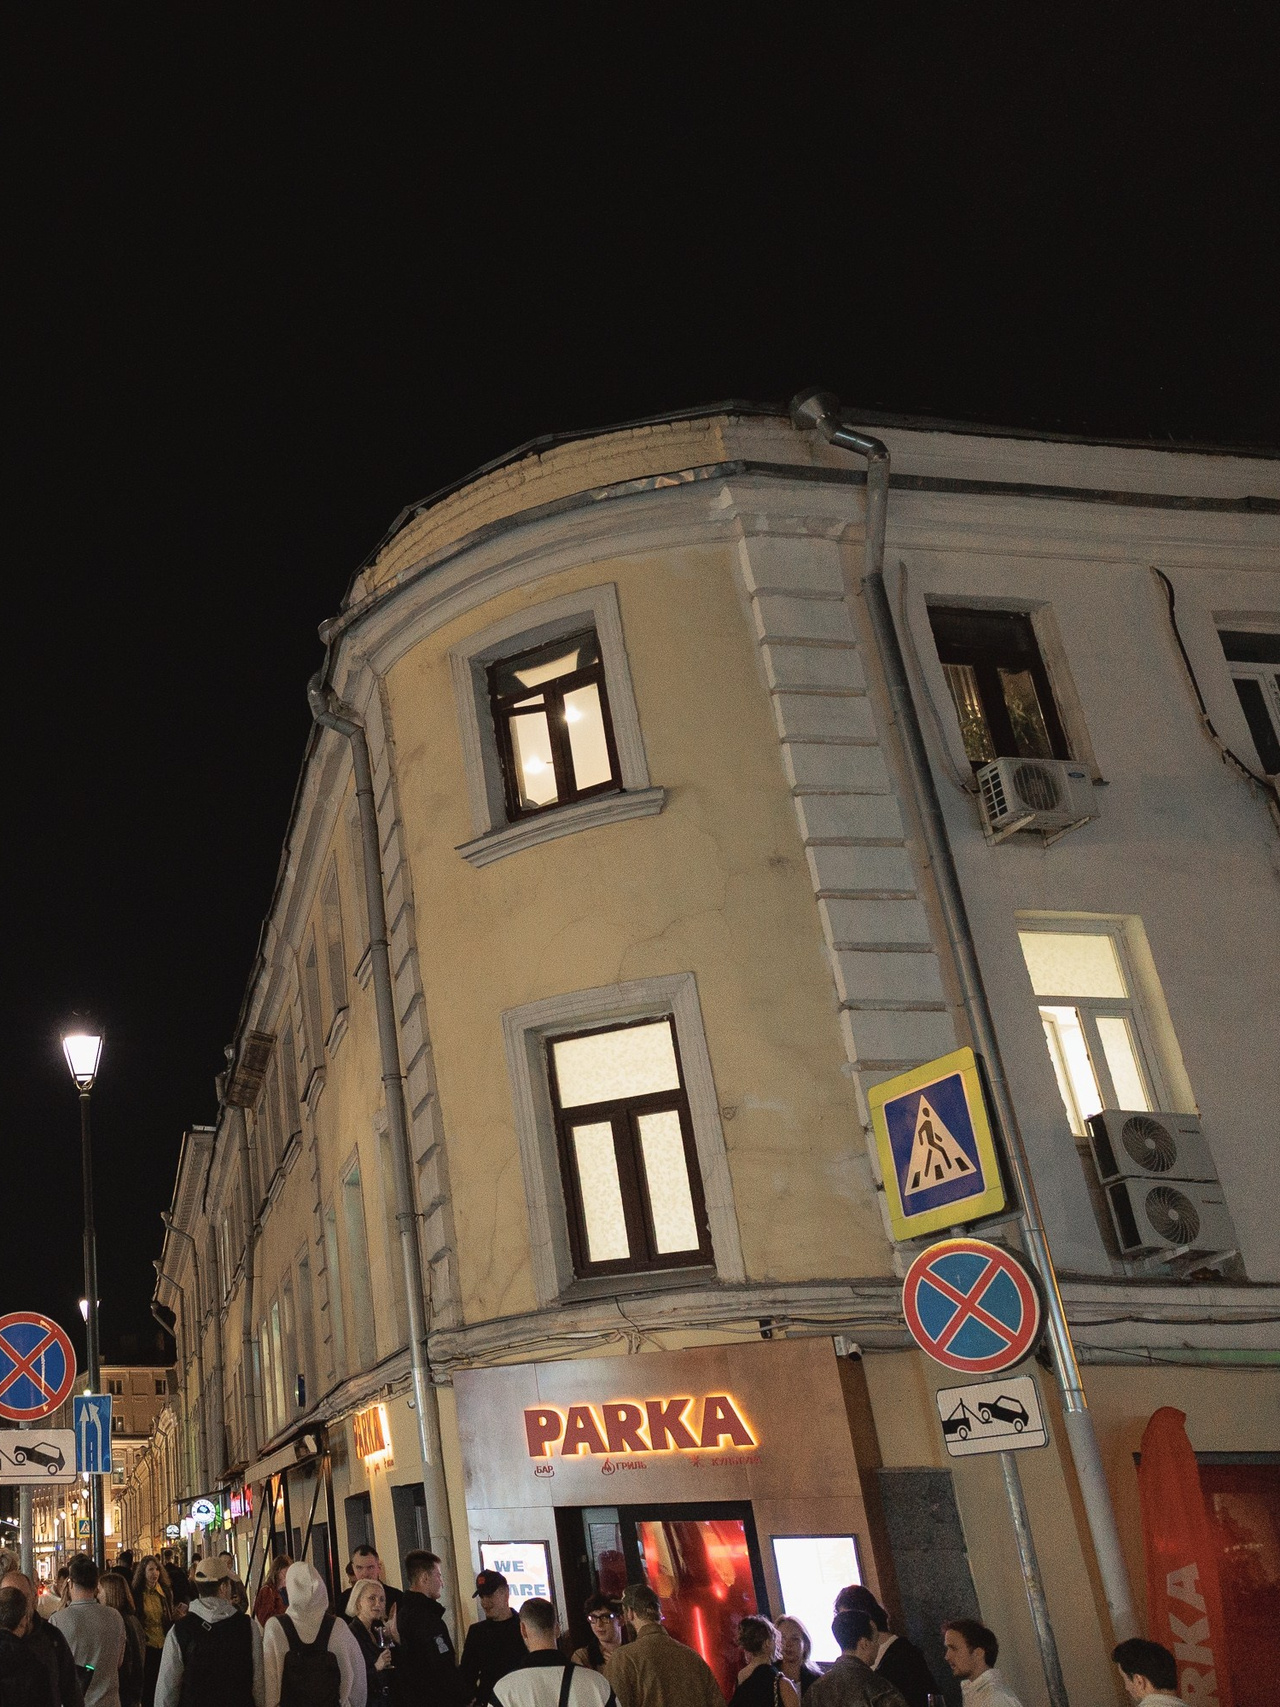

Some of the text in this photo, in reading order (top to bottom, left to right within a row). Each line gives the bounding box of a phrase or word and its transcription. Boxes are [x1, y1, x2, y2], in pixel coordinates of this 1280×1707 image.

[524, 1396, 755, 1457] PARKA
[536, 1465, 554, 1474] БАР
[616, 1462, 647, 1470] ГРИЛЬ
[494, 1561, 524, 1572] WE
[509, 1584, 546, 1596] ARE
